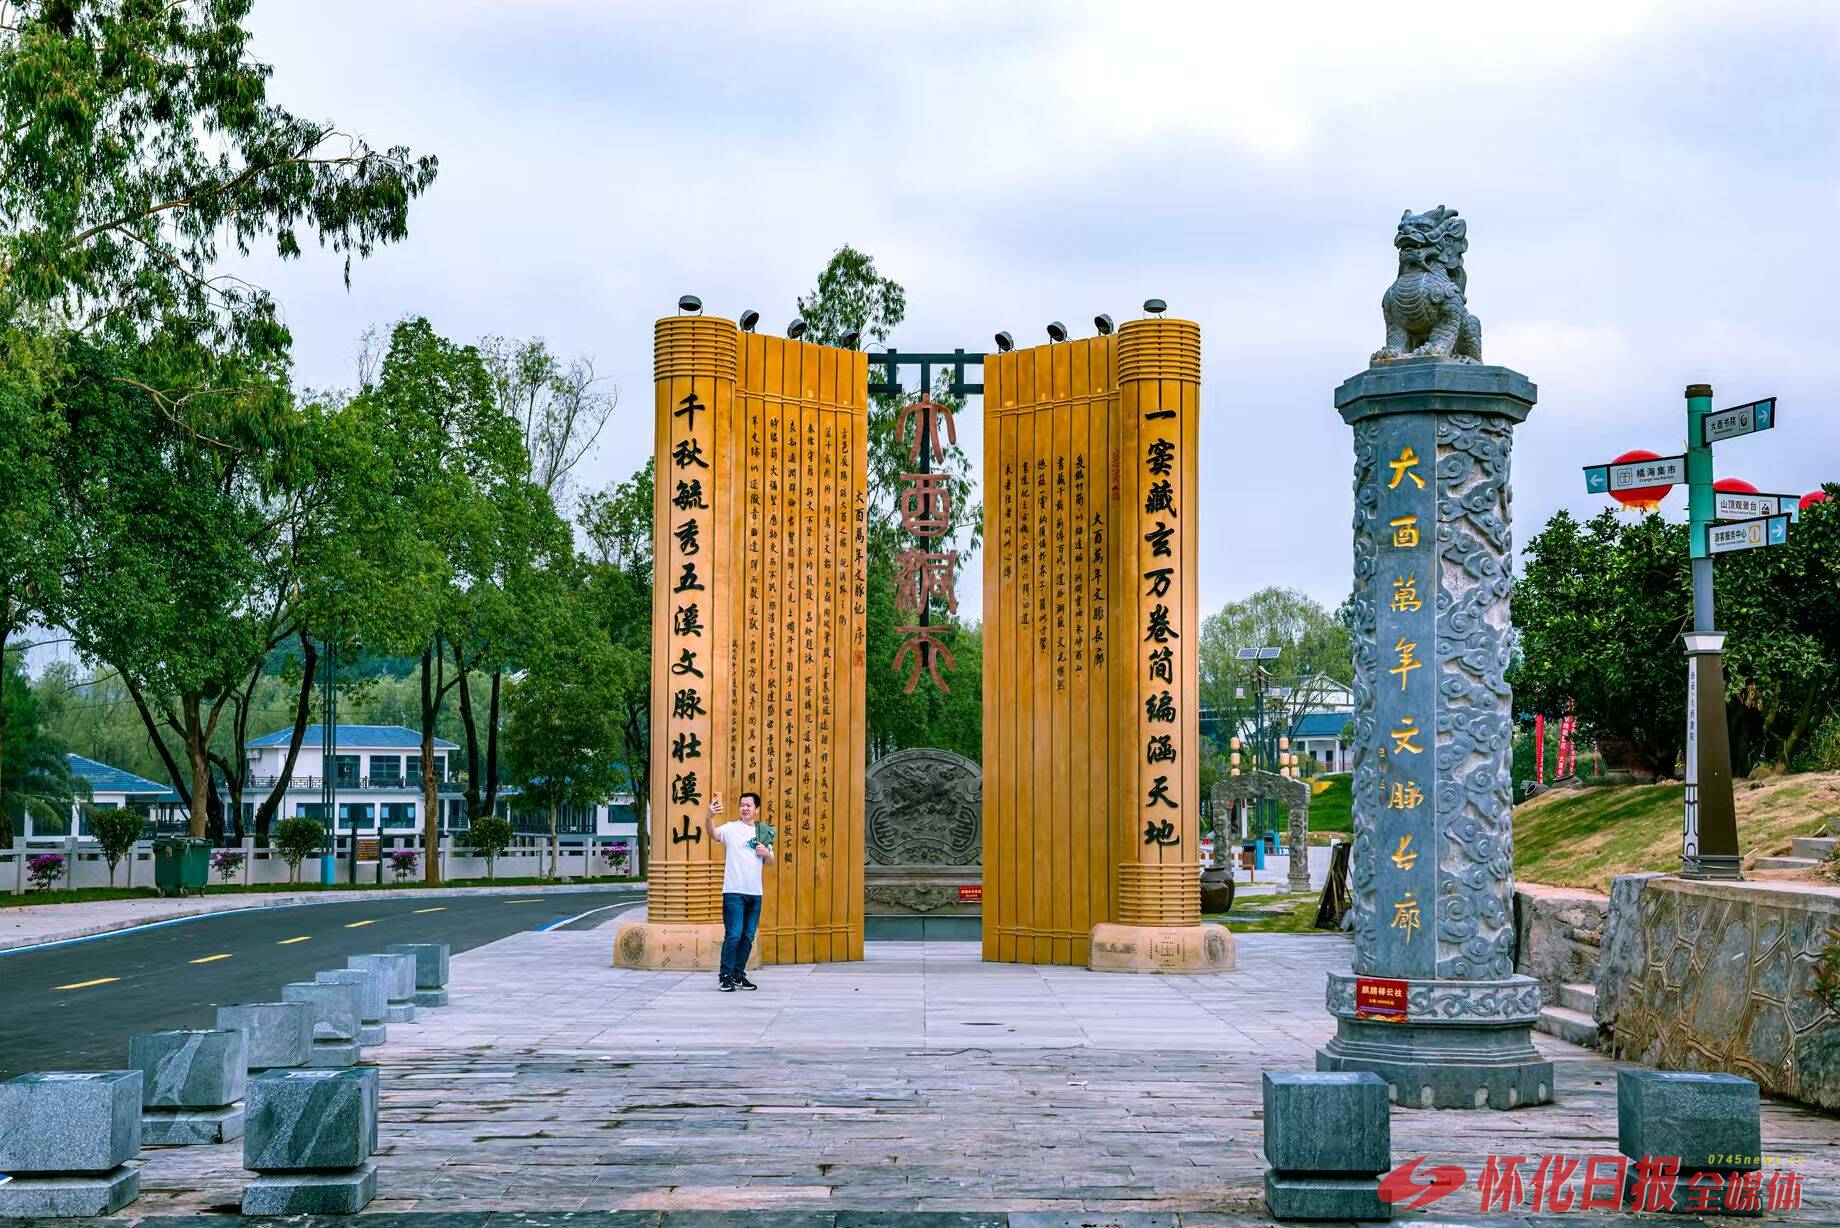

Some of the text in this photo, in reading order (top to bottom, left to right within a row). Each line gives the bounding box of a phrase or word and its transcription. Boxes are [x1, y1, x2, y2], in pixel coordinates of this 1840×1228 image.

[1710, 416, 1737, 432] 大酉书院
[1636, 465, 1677, 479] 橘海集市
[1720, 499, 1757, 511] 山顶观景台
[1714, 530, 1747, 542] 游客服务中心
